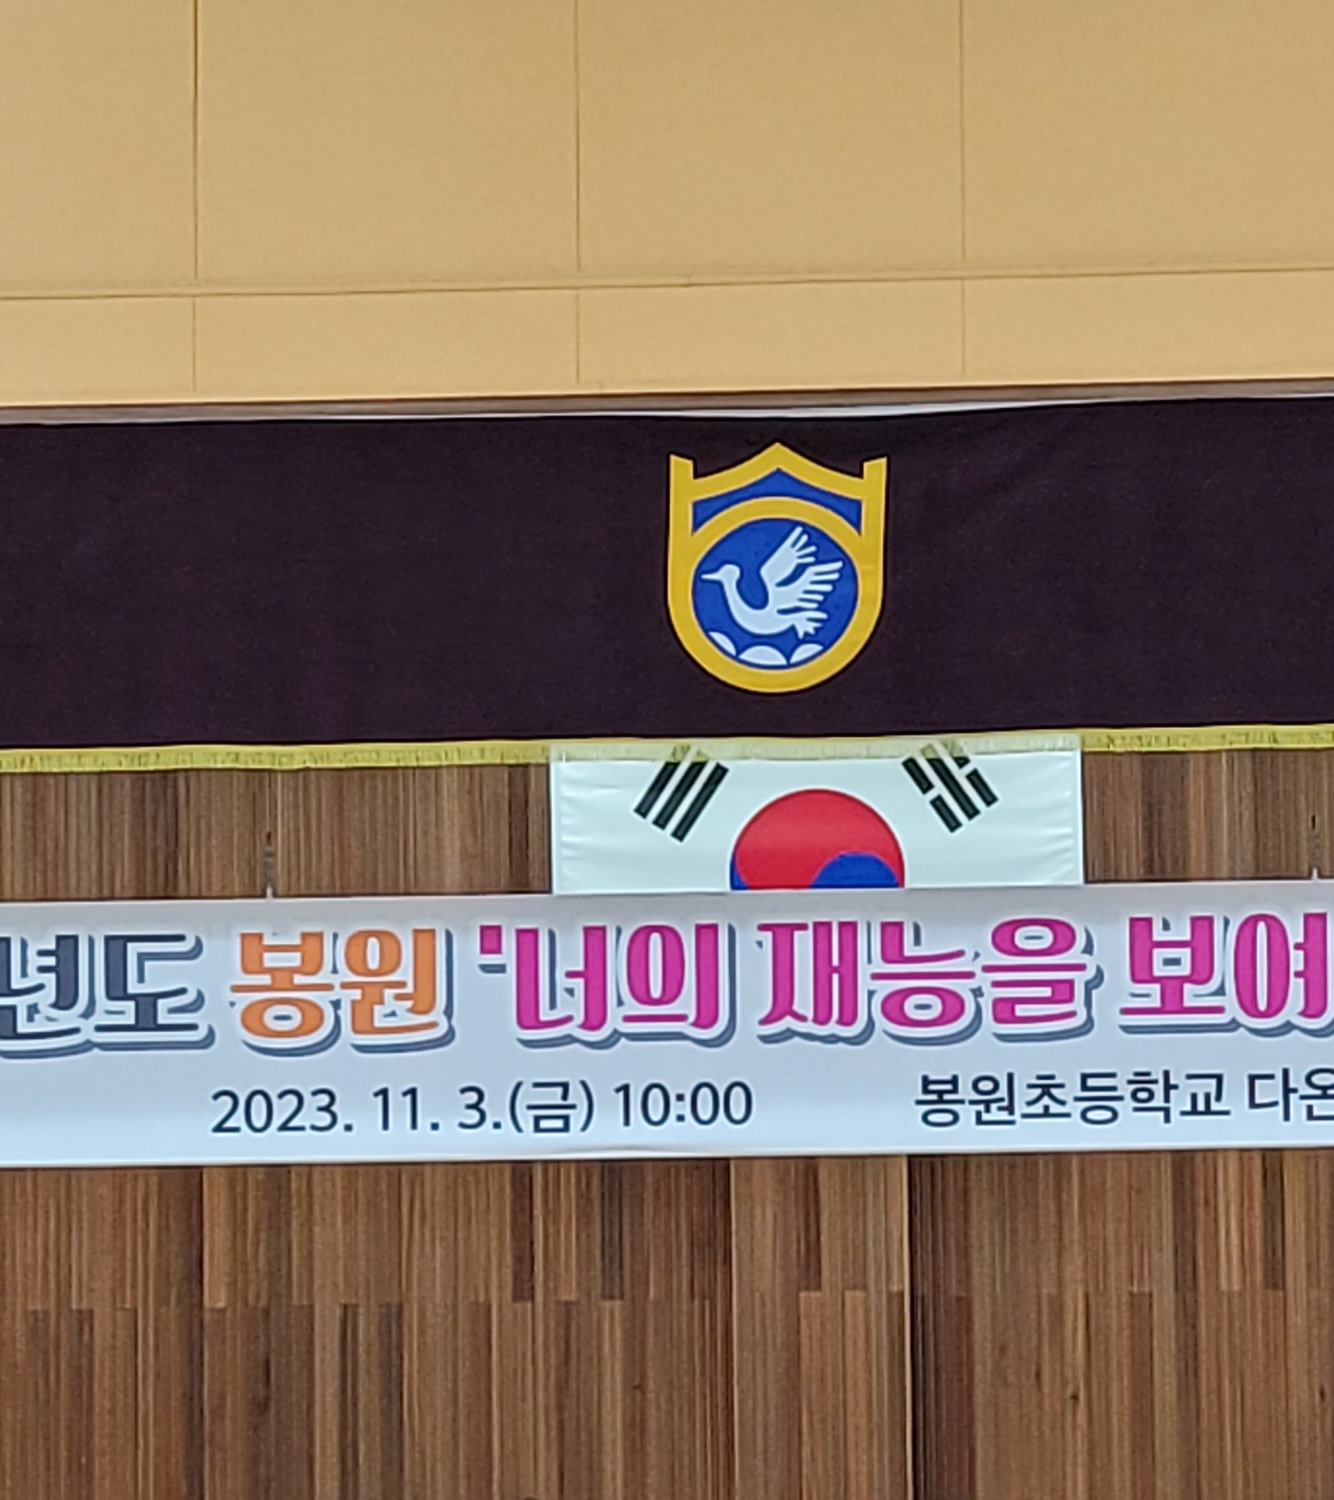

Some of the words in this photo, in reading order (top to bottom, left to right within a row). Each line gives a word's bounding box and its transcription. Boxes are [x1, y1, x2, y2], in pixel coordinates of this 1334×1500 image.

[229, 926, 443, 1042] 봉원
[757, 915, 1093, 1030] 재능을
[210, 1086, 357, 1133] 2023.
[372, 1086, 440, 1131] 11.
[614, 1080, 754, 1127] 10:00
[914, 1069, 1232, 1127] 봉원초등학교
